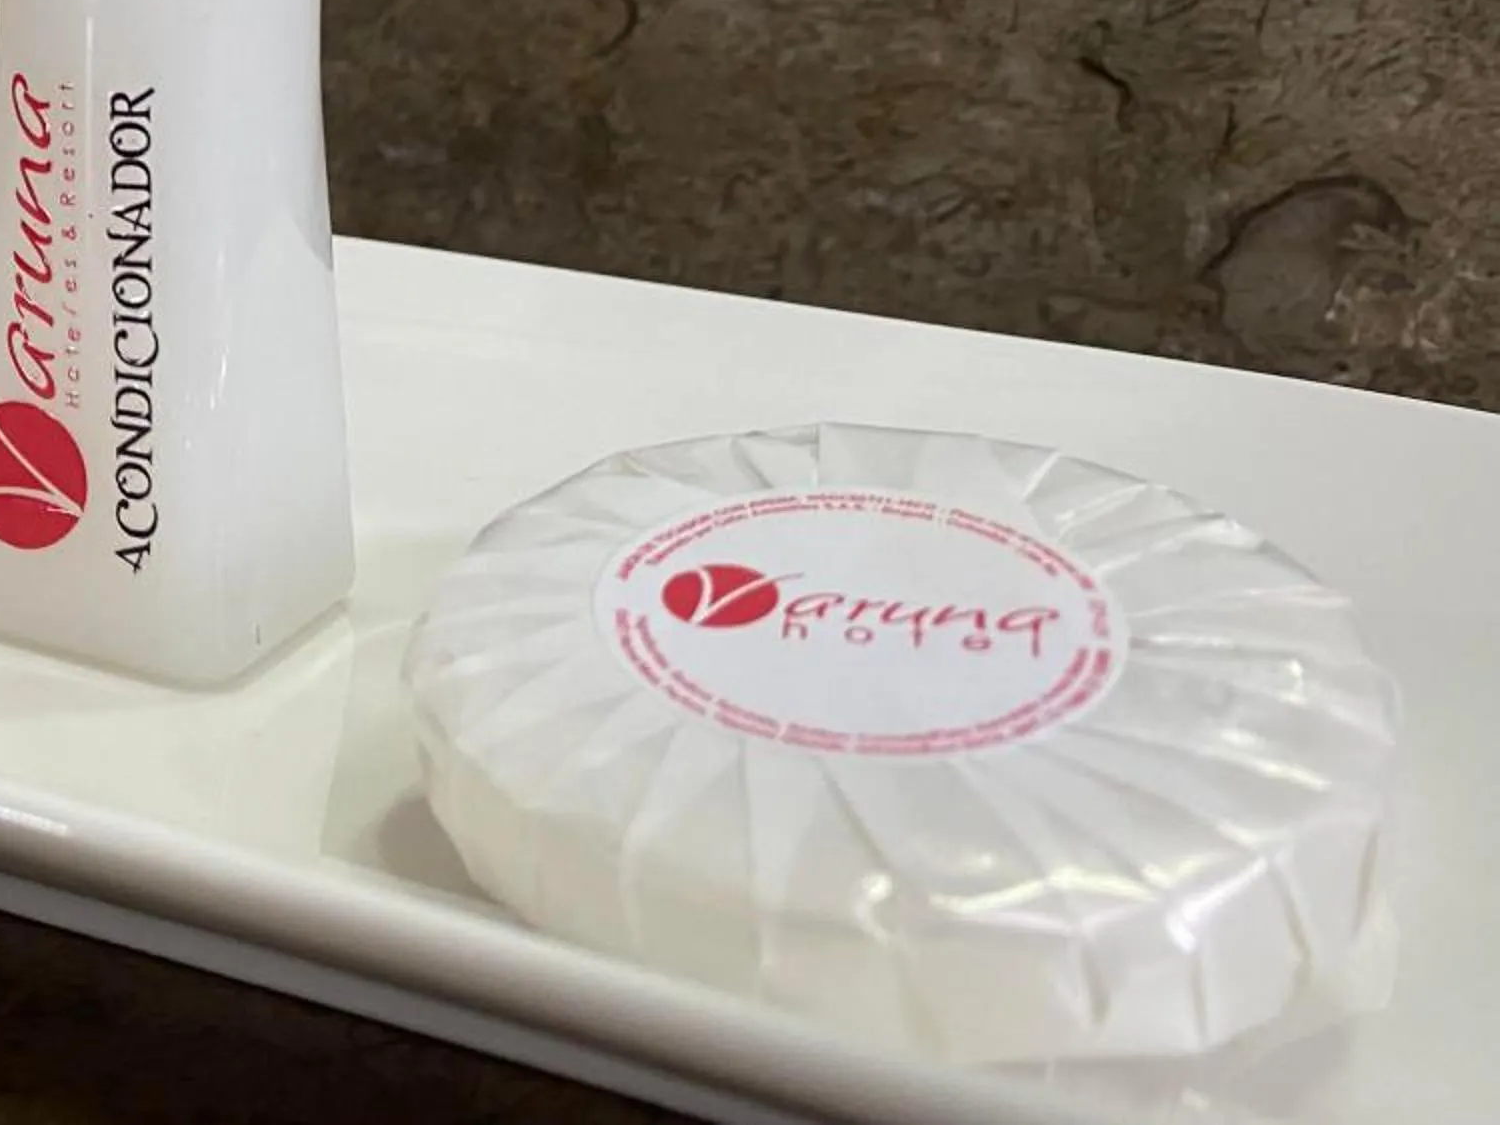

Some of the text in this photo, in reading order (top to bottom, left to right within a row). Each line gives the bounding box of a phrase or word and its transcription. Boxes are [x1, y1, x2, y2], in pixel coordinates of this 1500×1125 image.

[58, 81, 78, 207] Resort
[60, 224, 78, 241] &
[106, 87, 160, 575] ACONDICIONADOR
[661, 563, 1062, 631] Varuna
